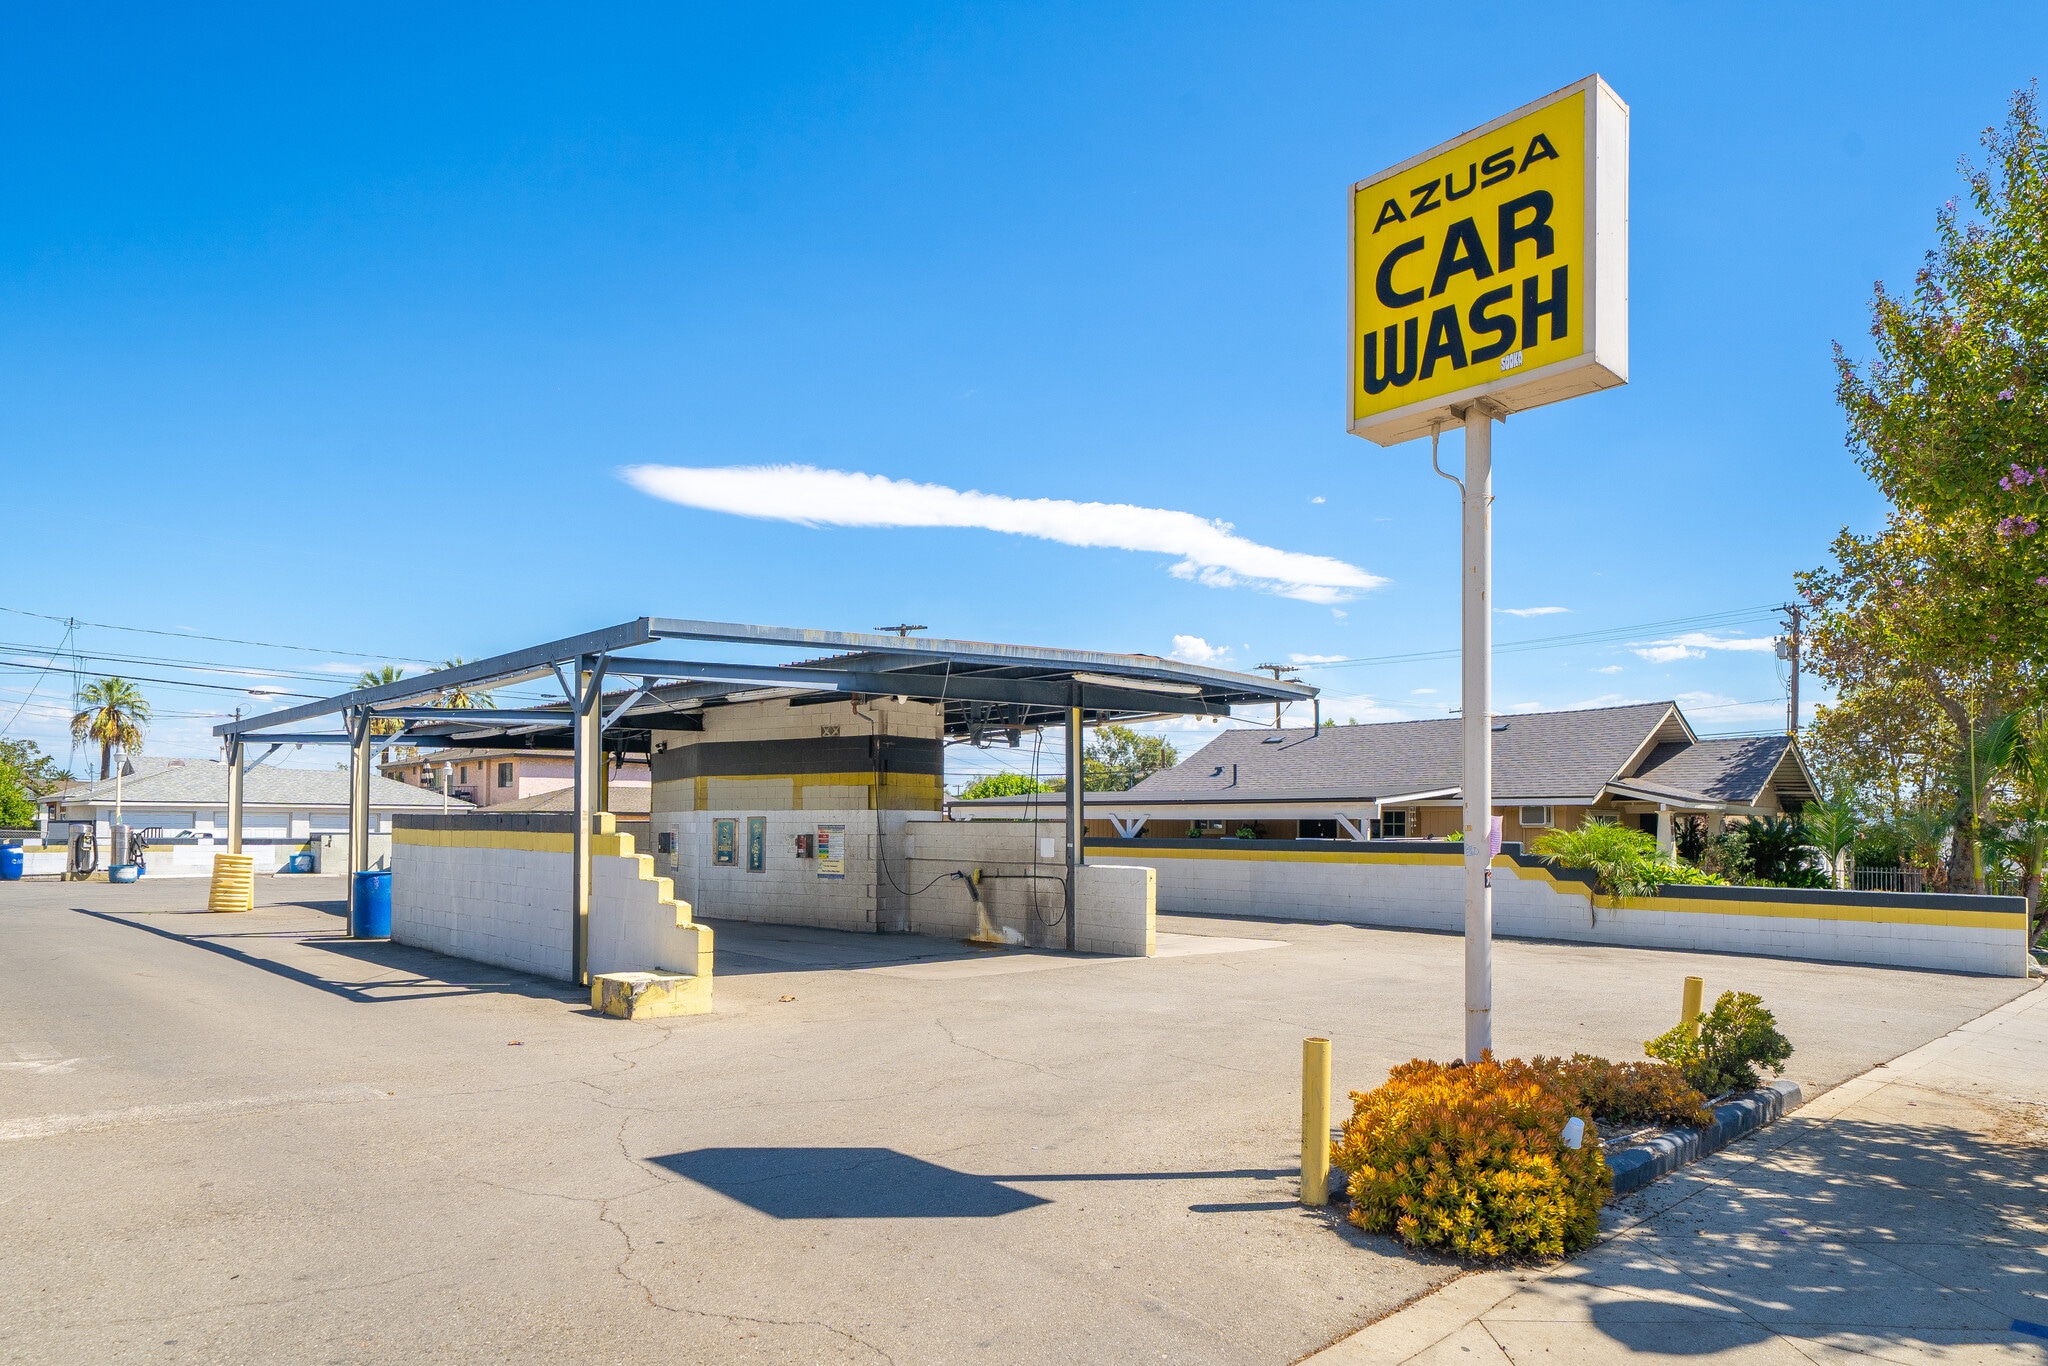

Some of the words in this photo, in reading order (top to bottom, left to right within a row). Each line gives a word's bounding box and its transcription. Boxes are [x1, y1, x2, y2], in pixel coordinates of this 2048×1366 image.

[1372, 133, 1560, 235] AZUSA
[1376, 190, 1555, 309] CAR
[1363, 264, 1569, 395] WASH
